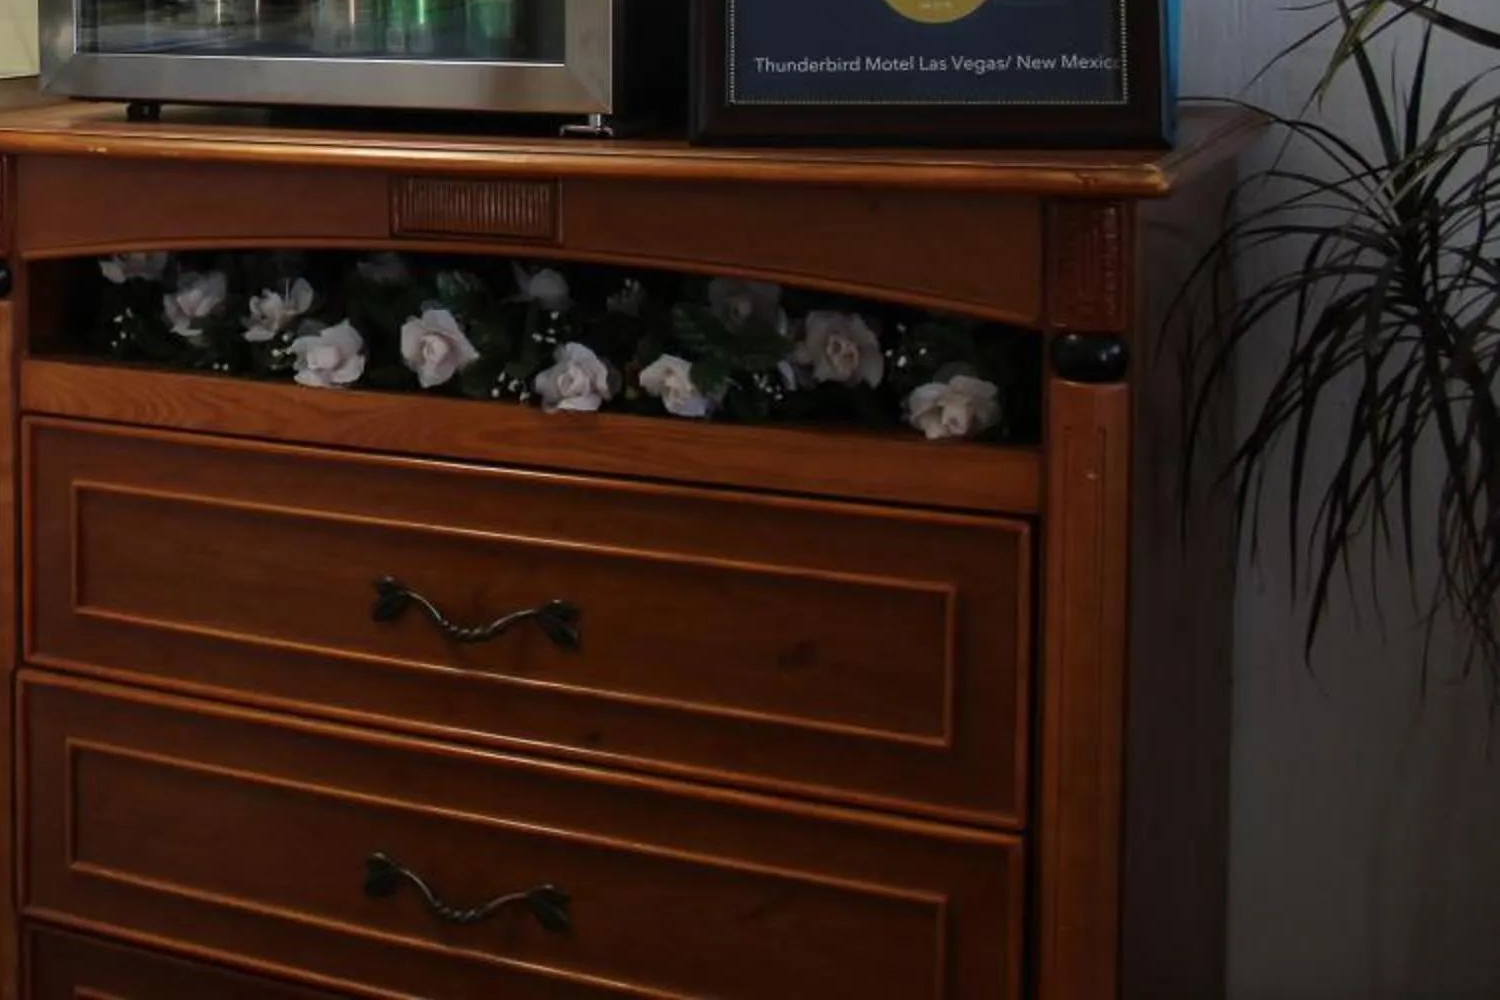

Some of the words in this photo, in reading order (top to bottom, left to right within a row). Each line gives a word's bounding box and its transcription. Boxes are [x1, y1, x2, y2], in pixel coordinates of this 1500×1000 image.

[755, 55, 861, 74] Thunderbird
[864, 55, 915, 72] Motel
[919, 55, 947, 71] Las
[951, 55, 1011, 76] Vegas/
[1017, 55, 1056, 71] New
